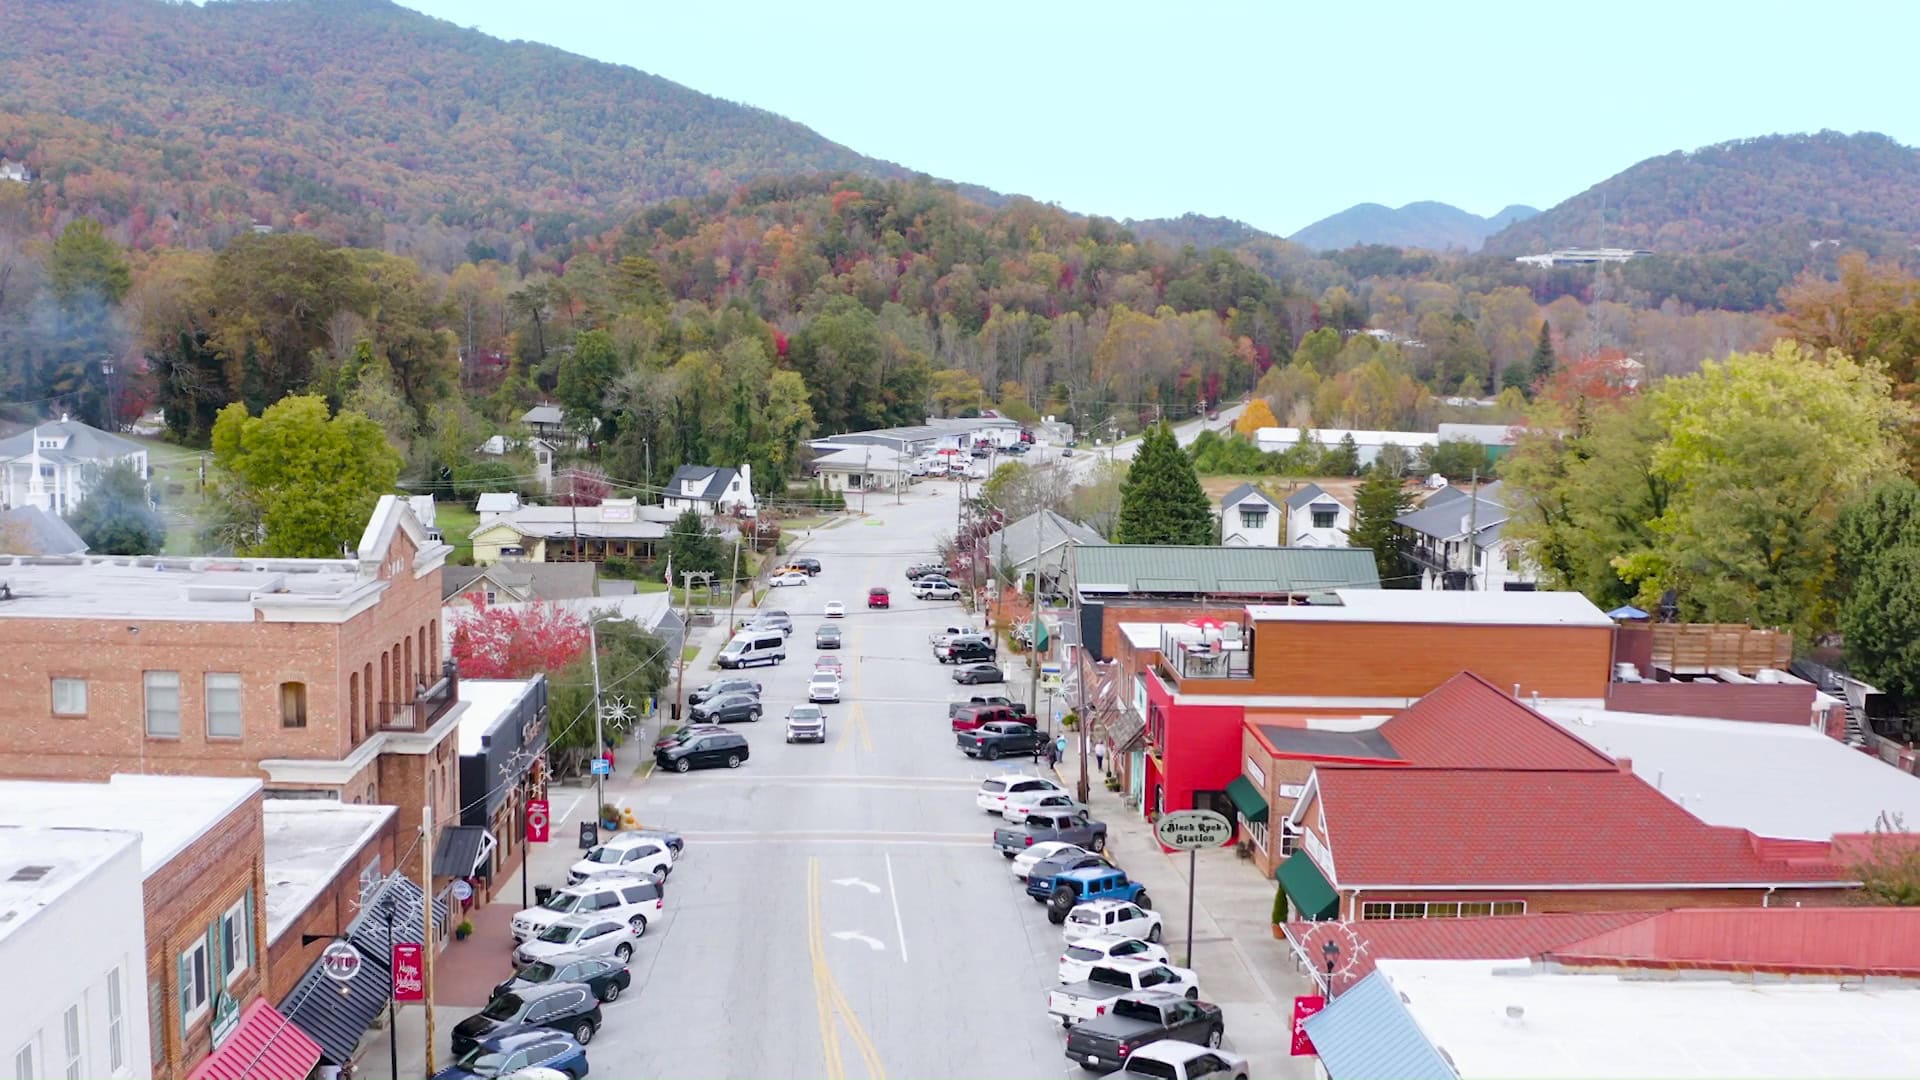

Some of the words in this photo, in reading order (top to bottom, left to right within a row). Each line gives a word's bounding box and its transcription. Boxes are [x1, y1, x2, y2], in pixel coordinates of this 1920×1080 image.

[1167, 824, 1195, 833] Black
[1198, 823, 1221, 833] Rock
[1176, 834, 1214, 844] Station
